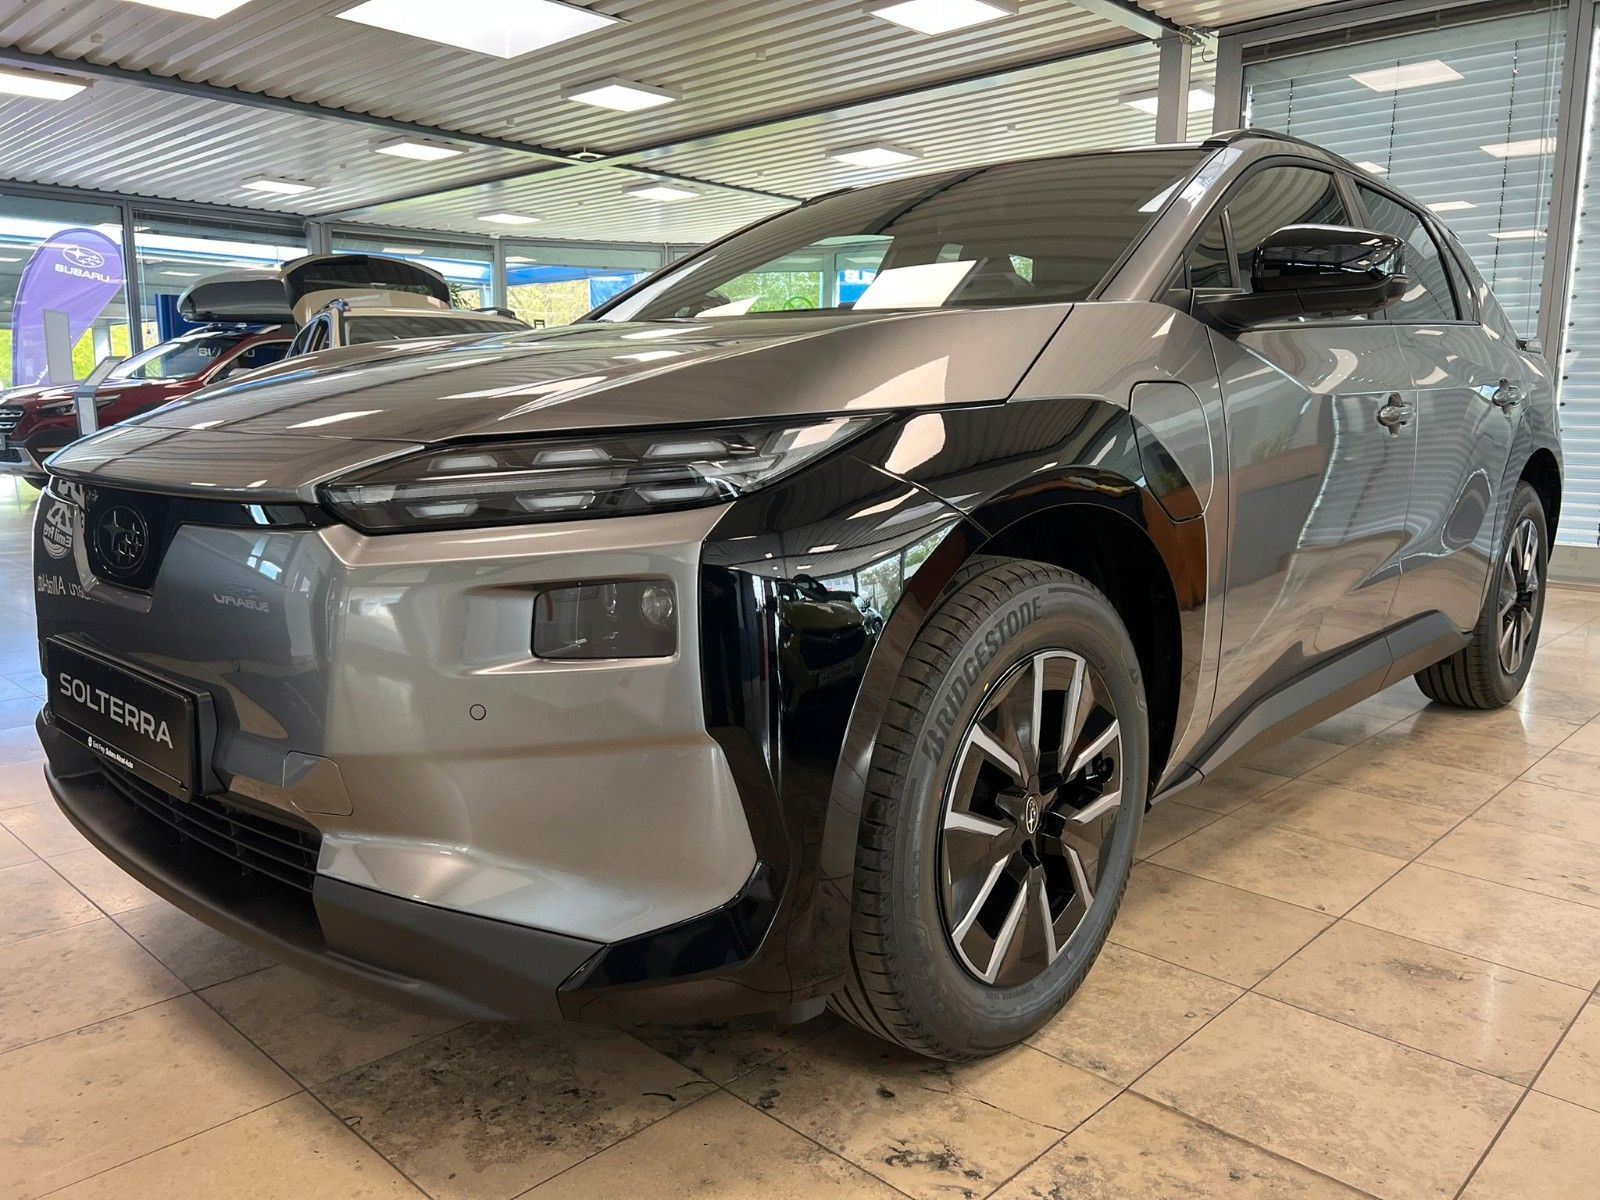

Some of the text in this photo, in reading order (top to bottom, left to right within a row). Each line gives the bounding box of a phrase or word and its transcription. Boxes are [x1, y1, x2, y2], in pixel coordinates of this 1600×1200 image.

[54, 263, 110, 283] SUBARU
[59, 672, 174, 750] SOLTERRA
[921, 596, 1042, 766] BRIDGESTONE
